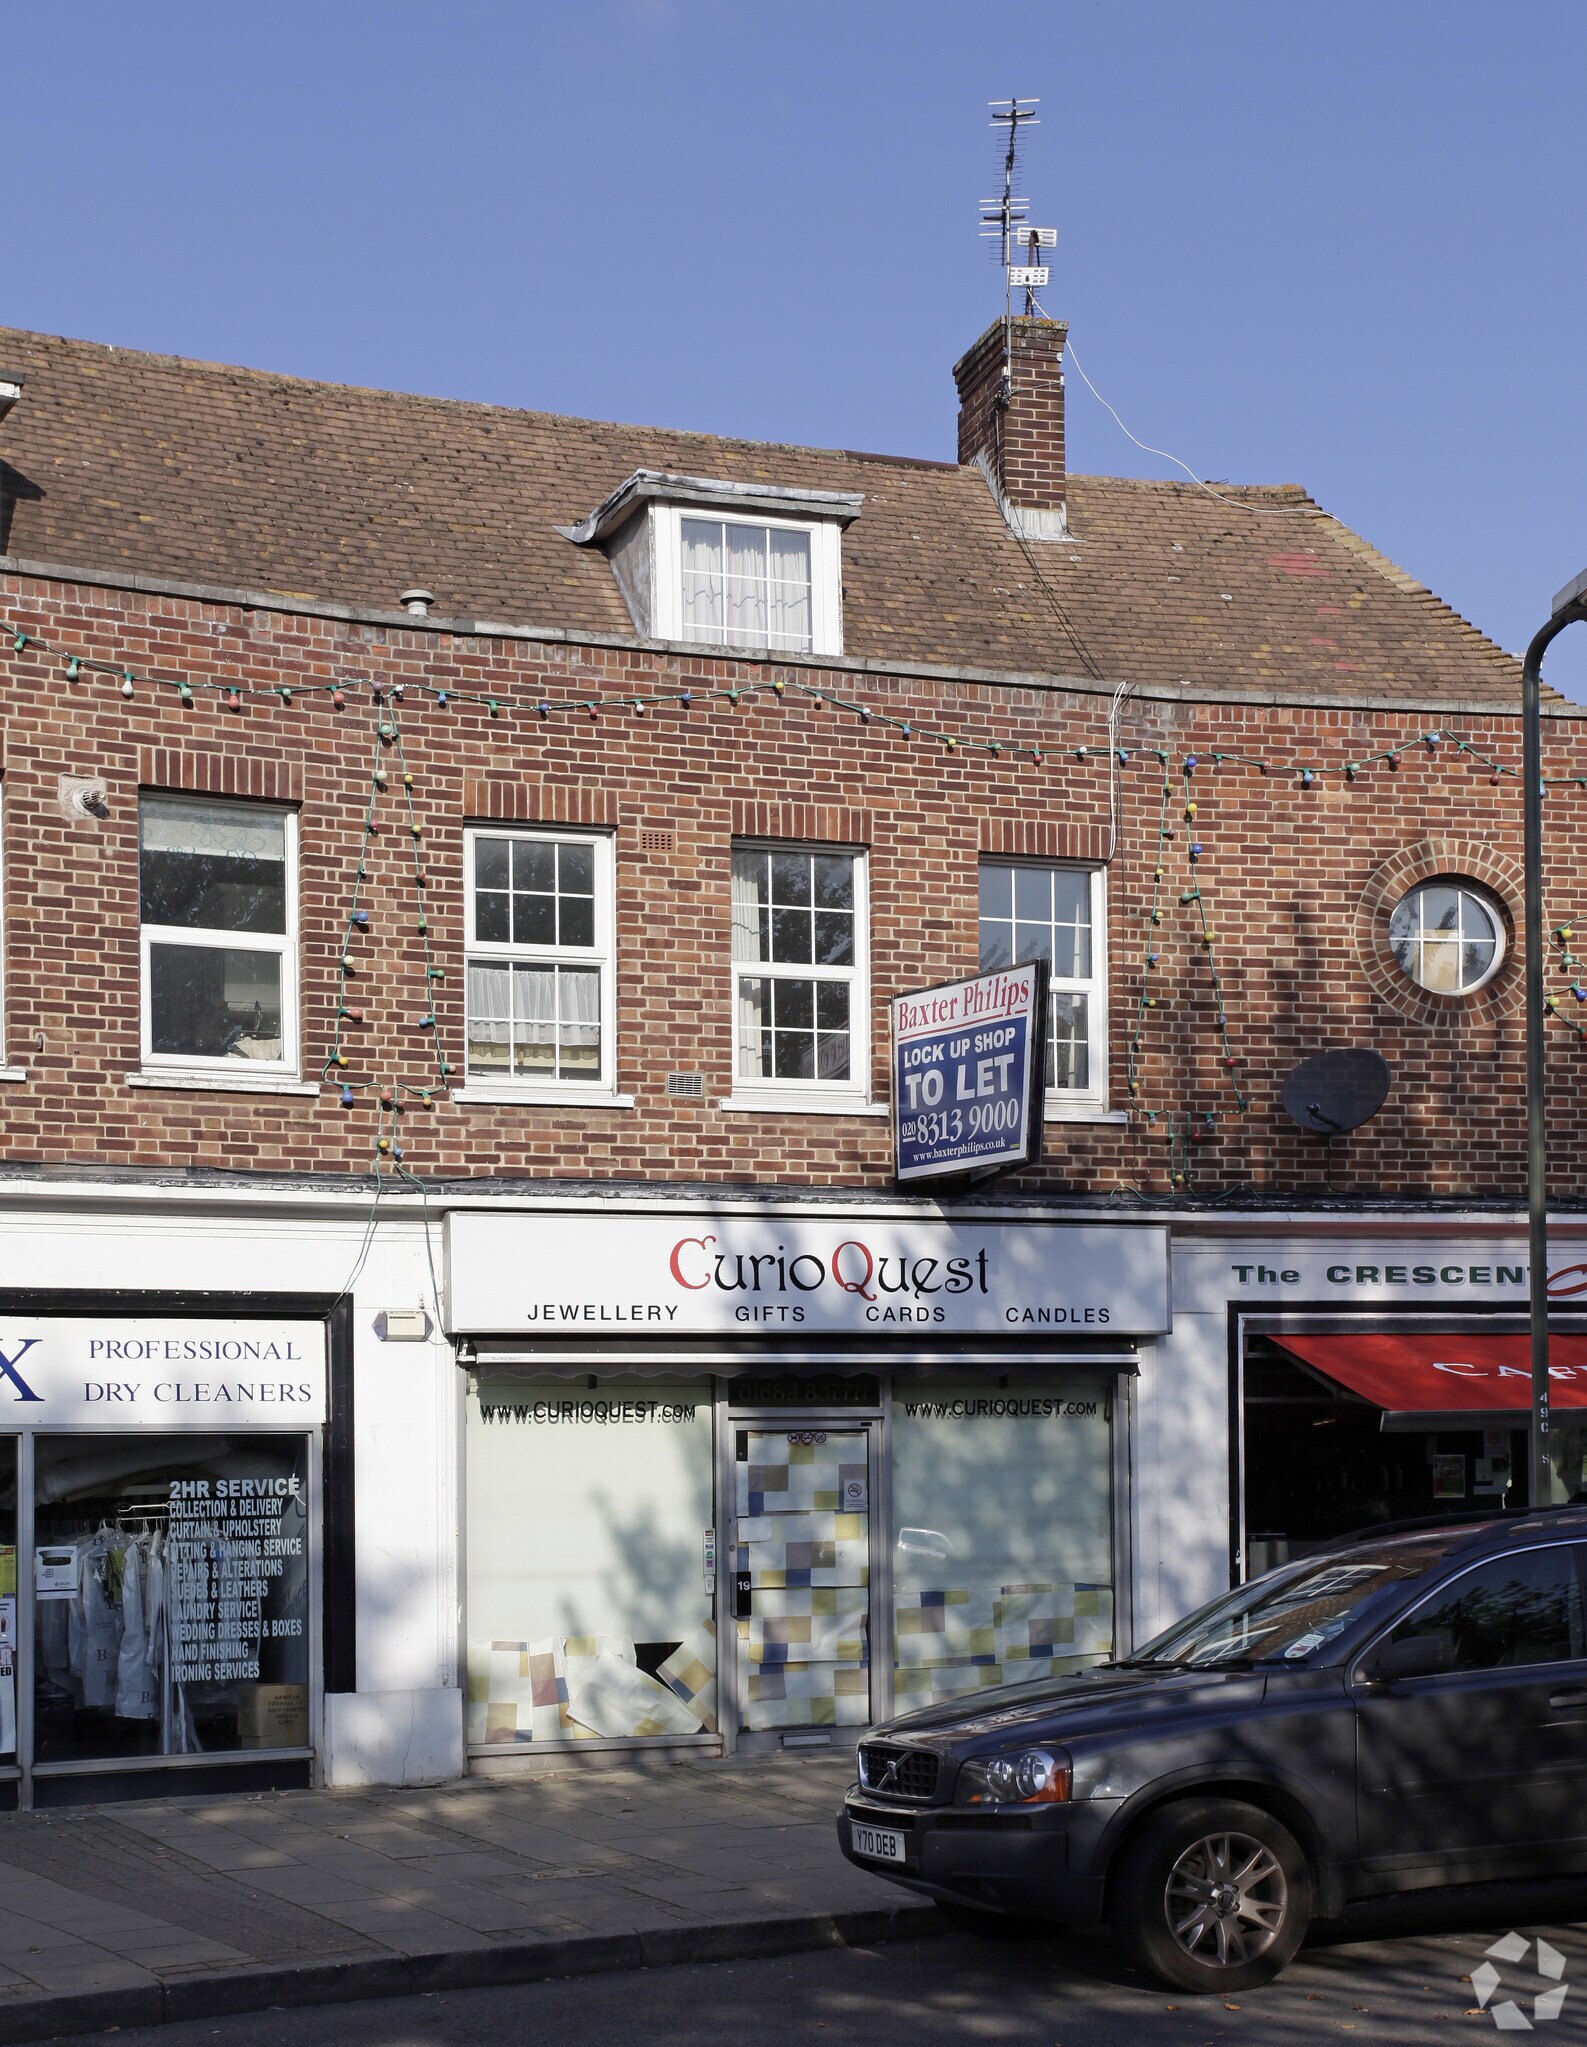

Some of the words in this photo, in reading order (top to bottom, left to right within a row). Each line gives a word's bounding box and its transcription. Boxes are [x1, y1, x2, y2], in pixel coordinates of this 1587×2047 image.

[898, 997, 958, 1032] Baxter
[962, 976, 1029, 1017] Philips
[904, 1043, 945, 1069] LOCK
[950, 1038, 971, 1059] UP
[974, 1027, 1016, 1054] SHOP
[905, 1069, 944, 1110] TO
[957, 1053, 1015, 1101] LET
[902, 1121, 916, 1138] 020
[917, 1108, 963, 1146] 8313
[968, 1098, 1019, 1141] 9000
[913, 1137, 1006, 1162] www.baxterphilips.co.uk
[1232, 1265, 1301, 1283] The
[1326, 1265, 1548, 1285] CRESCEN
[527, 1304, 679, 1321] JEWELLERY
[735, 1306, 805, 1322] GIFTS
[866, 1306, 946, 1323] CARDS
[1005, 1307, 1110, 1324] CANDLES
[88, 1340, 302, 1361] PROFESSIONAL
[83, 1382, 142, 1403] DRY
[154, 1382, 312, 1403] CLEANERS
[479, 1401, 696, 1420] WWW.CURIOQUEST.COM
[905, 1399, 1097, 1417] WWW.CURIOQUEST.COM
[169, 1480, 210, 1499] 2HR
[215, 1477, 300, 1498] SERVICE
[169, 1500, 227, 1518] COLLECTION
[230, 1499, 237, 1517] &
[239, 1497, 283, 1516] DELIVERY
[170, 1520, 210, 1539] CURTAIN
[213, 1520, 220, 1538] &
[222, 1518, 282, 1538] UPHOLSTERY
[170, 1541, 207, 1560] FITTING
[210, 1540, 217, 1559] &
[219, 1539, 261, 1559] HANGING
[263, 1537, 302, 1557] SERVICE
[171, 1561, 210, 1581] REPAIRS
[211, 1561, 219, 1579] &
[221, 1558, 283, 1579] ALTERATIONS
[171, 1582, 209, 1600] SUEDES
[211, 1580, 218, 1599] &
[220, 1579, 269, 1598] LEATHERS
[737, 1581, 751, 1591] 19
[218, 1600, 258, 1620] SERVICE
[171, 1622, 216, 1642] WEDDING
[217, 1620, 260, 1640] DRESSES
[262, 1620, 270, 1638] &
[271, 1618, 302, 1637] BOXES
[172, 1643, 198, 1662] HAND
[200, 1641, 249, 1660] FINISHING
[171, 1663, 212, 1682] IRONING
[214, 1661, 260, 1681] SERVICES
[857, 1829, 874, 1853] Y70
[876, 1833, 897, 1857] DEB
